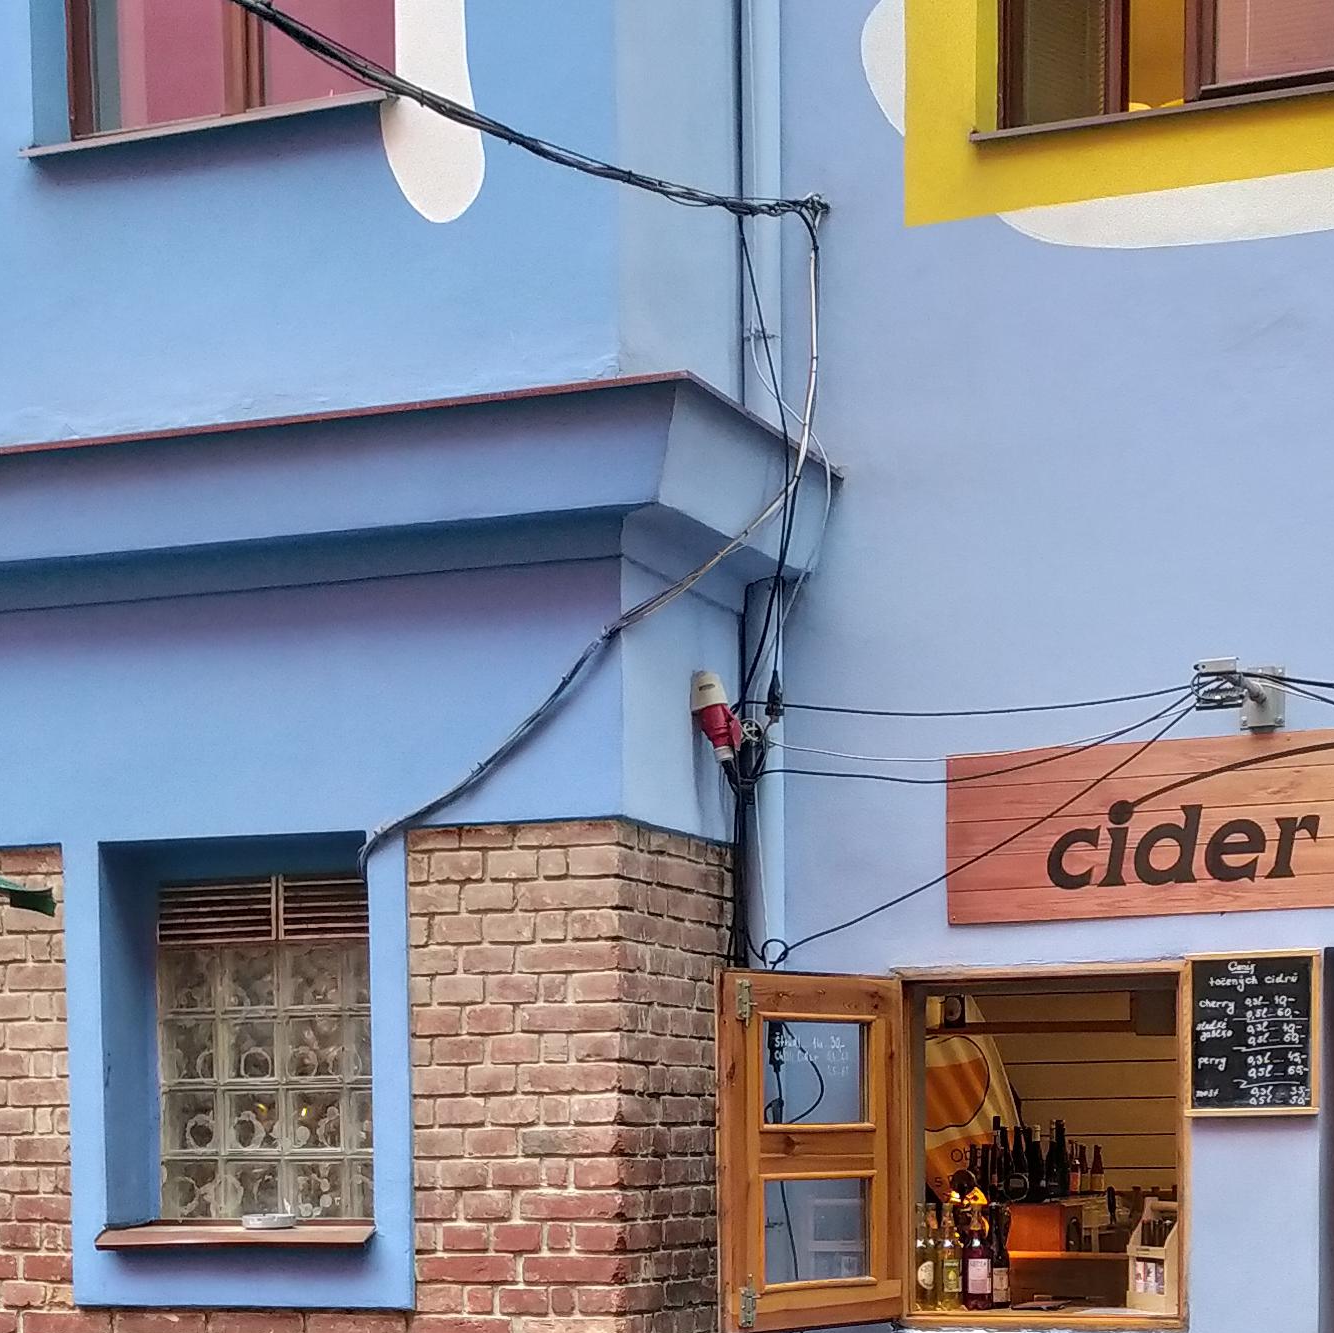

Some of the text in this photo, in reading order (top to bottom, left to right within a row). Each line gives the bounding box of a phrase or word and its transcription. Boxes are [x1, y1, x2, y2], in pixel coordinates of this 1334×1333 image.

[1046, 799, 1319, 891] cider
[1264, 972, 1298, 984] cidrů
[1199, 998, 1235, 1015] cherry
[1197, 1057, 1227, 1071] perry
